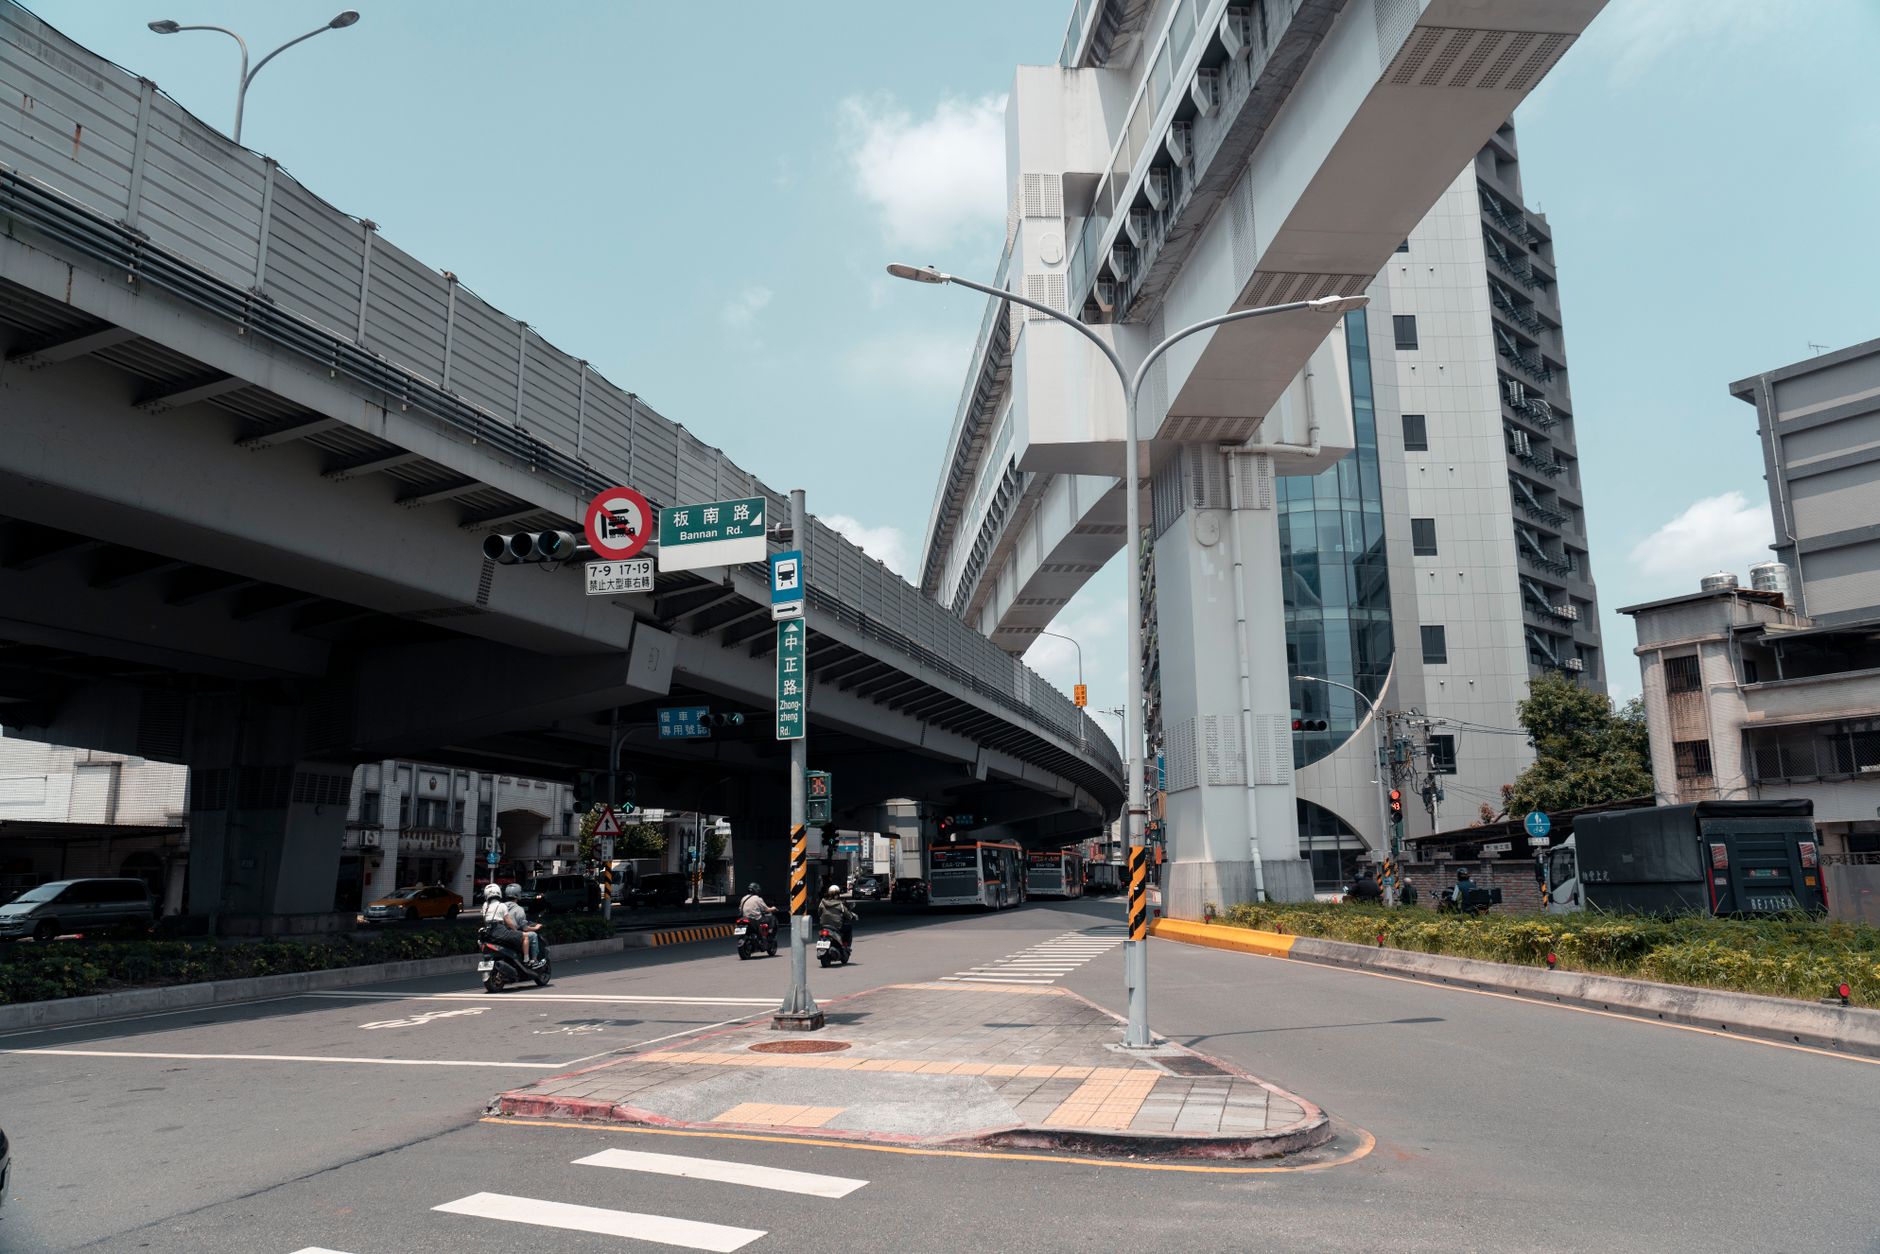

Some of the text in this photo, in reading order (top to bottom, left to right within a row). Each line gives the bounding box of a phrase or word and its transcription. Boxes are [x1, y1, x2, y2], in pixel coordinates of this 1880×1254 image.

[673, 504, 750, 528] 板南路
[680, 526, 743, 541] Bannan Rd.
[589, 562, 650, 578] 7-9 17-19
[589, 576, 650, 592] 禁止大型車右轉
[783, 634, 798, 697] 中正路
[779, 699, 801, 711] Zhong-
[780, 712, 798, 723] zheng
[779, 726, 791, 736] Rd.
